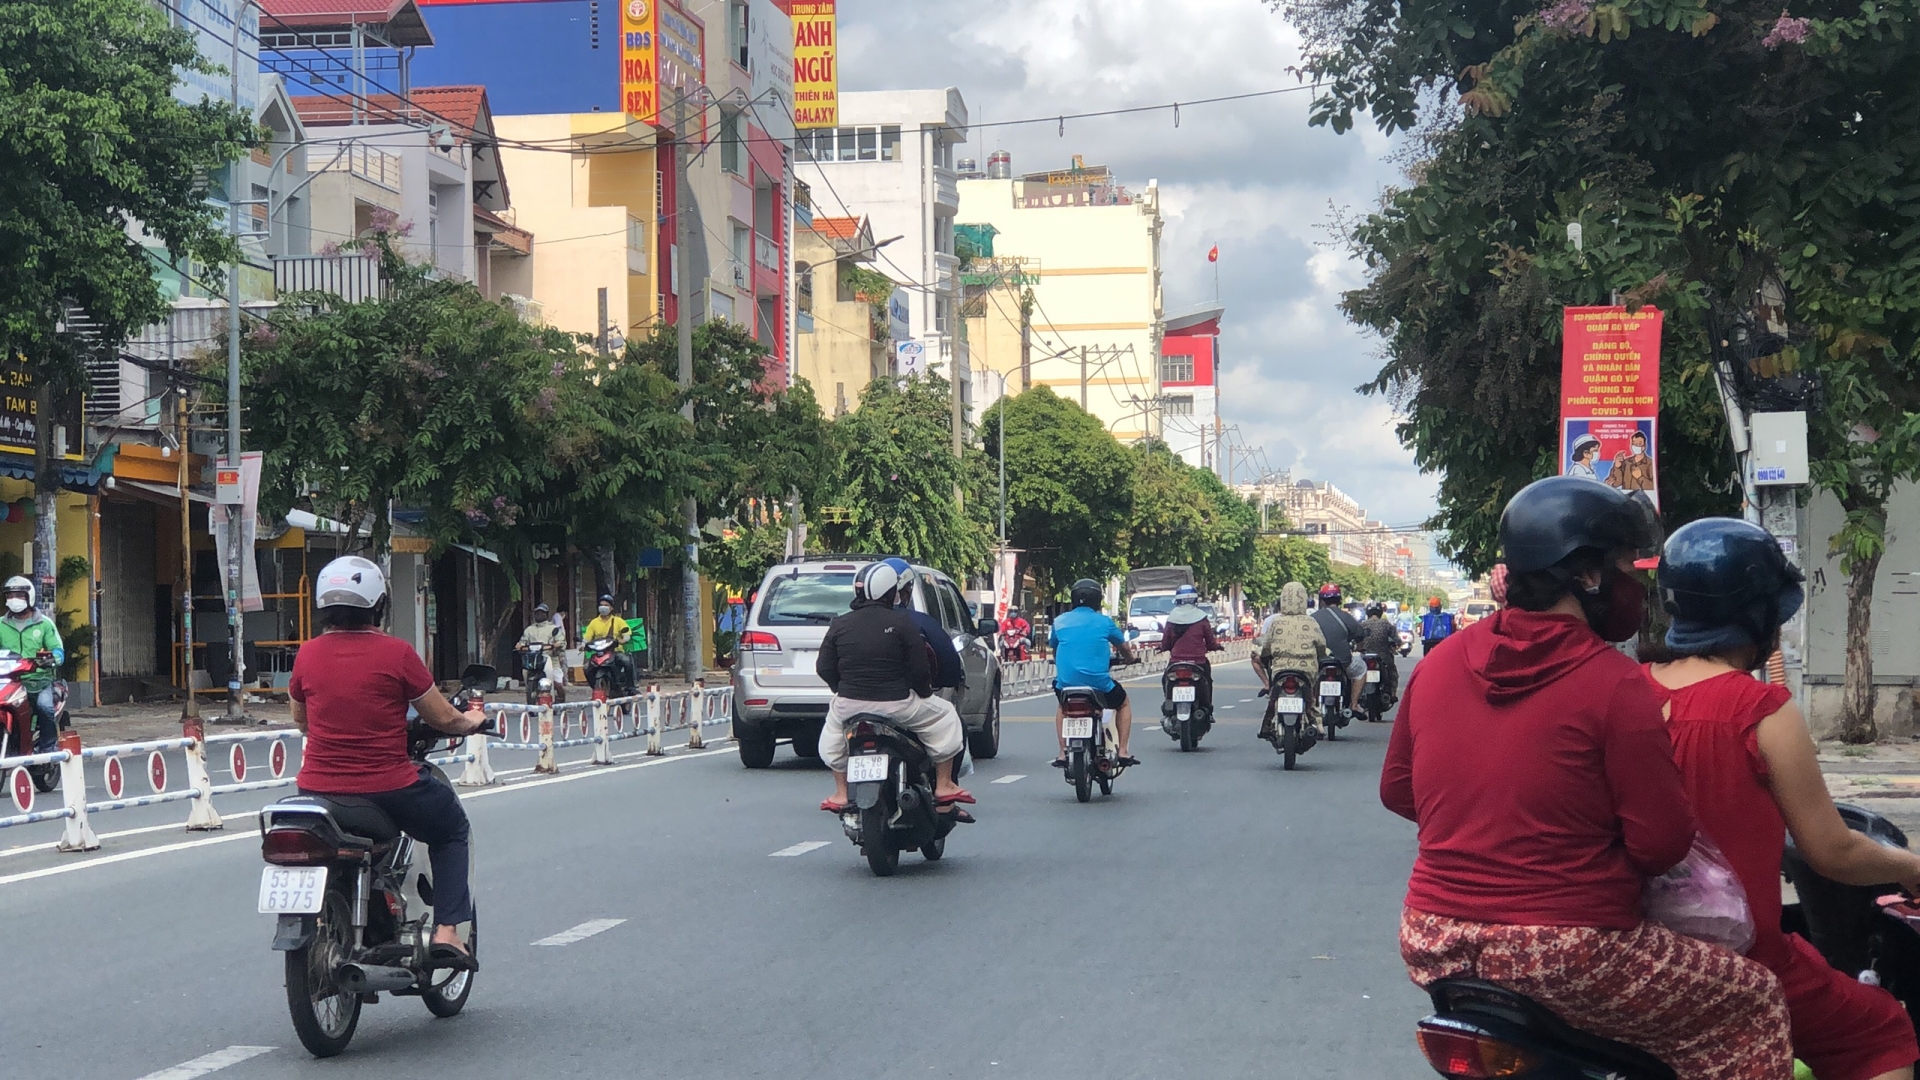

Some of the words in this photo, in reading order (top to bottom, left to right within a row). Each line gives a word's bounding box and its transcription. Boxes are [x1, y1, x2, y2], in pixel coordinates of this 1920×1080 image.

[792, 4, 815, 14] TRUNG
[818, 2, 833, 14] TÂM
[795, 21, 832, 47] ANH
[626, 31, 651, 50] BĐS
[625, 59, 652, 84] HOA
[794, 51, 834, 83] NGỮ
[795, 89, 820, 102] THIÊN
[822, 89, 835, 101] HÀ
[627, 90, 652, 116] SEN
[795, 107, 835, 123] GALAXY
[1583, 351, 1611, 361] CHÍNH
[1583, 363, 1594, 372] VÀ
[1596, 363, 1622, 372] NHÂN
[1583, 374, 1608, 384] QUẬN
[1610, 374, 1623, 383] GÒ
[1625, 374, 1639, 383] VẤP
[1588, 385, 1620, 394] CHUNG
[1567, 395, 1600, 405] PHÒNG,
[1603, 394, 1634, 405] CHỐNG
[1635, 396, 1654, 406] DỊCH
[1591, 407, 1633, 416] COVID-19
[854, 768, 882, 780] 9049
[268, 890, 314, 909] 6375
